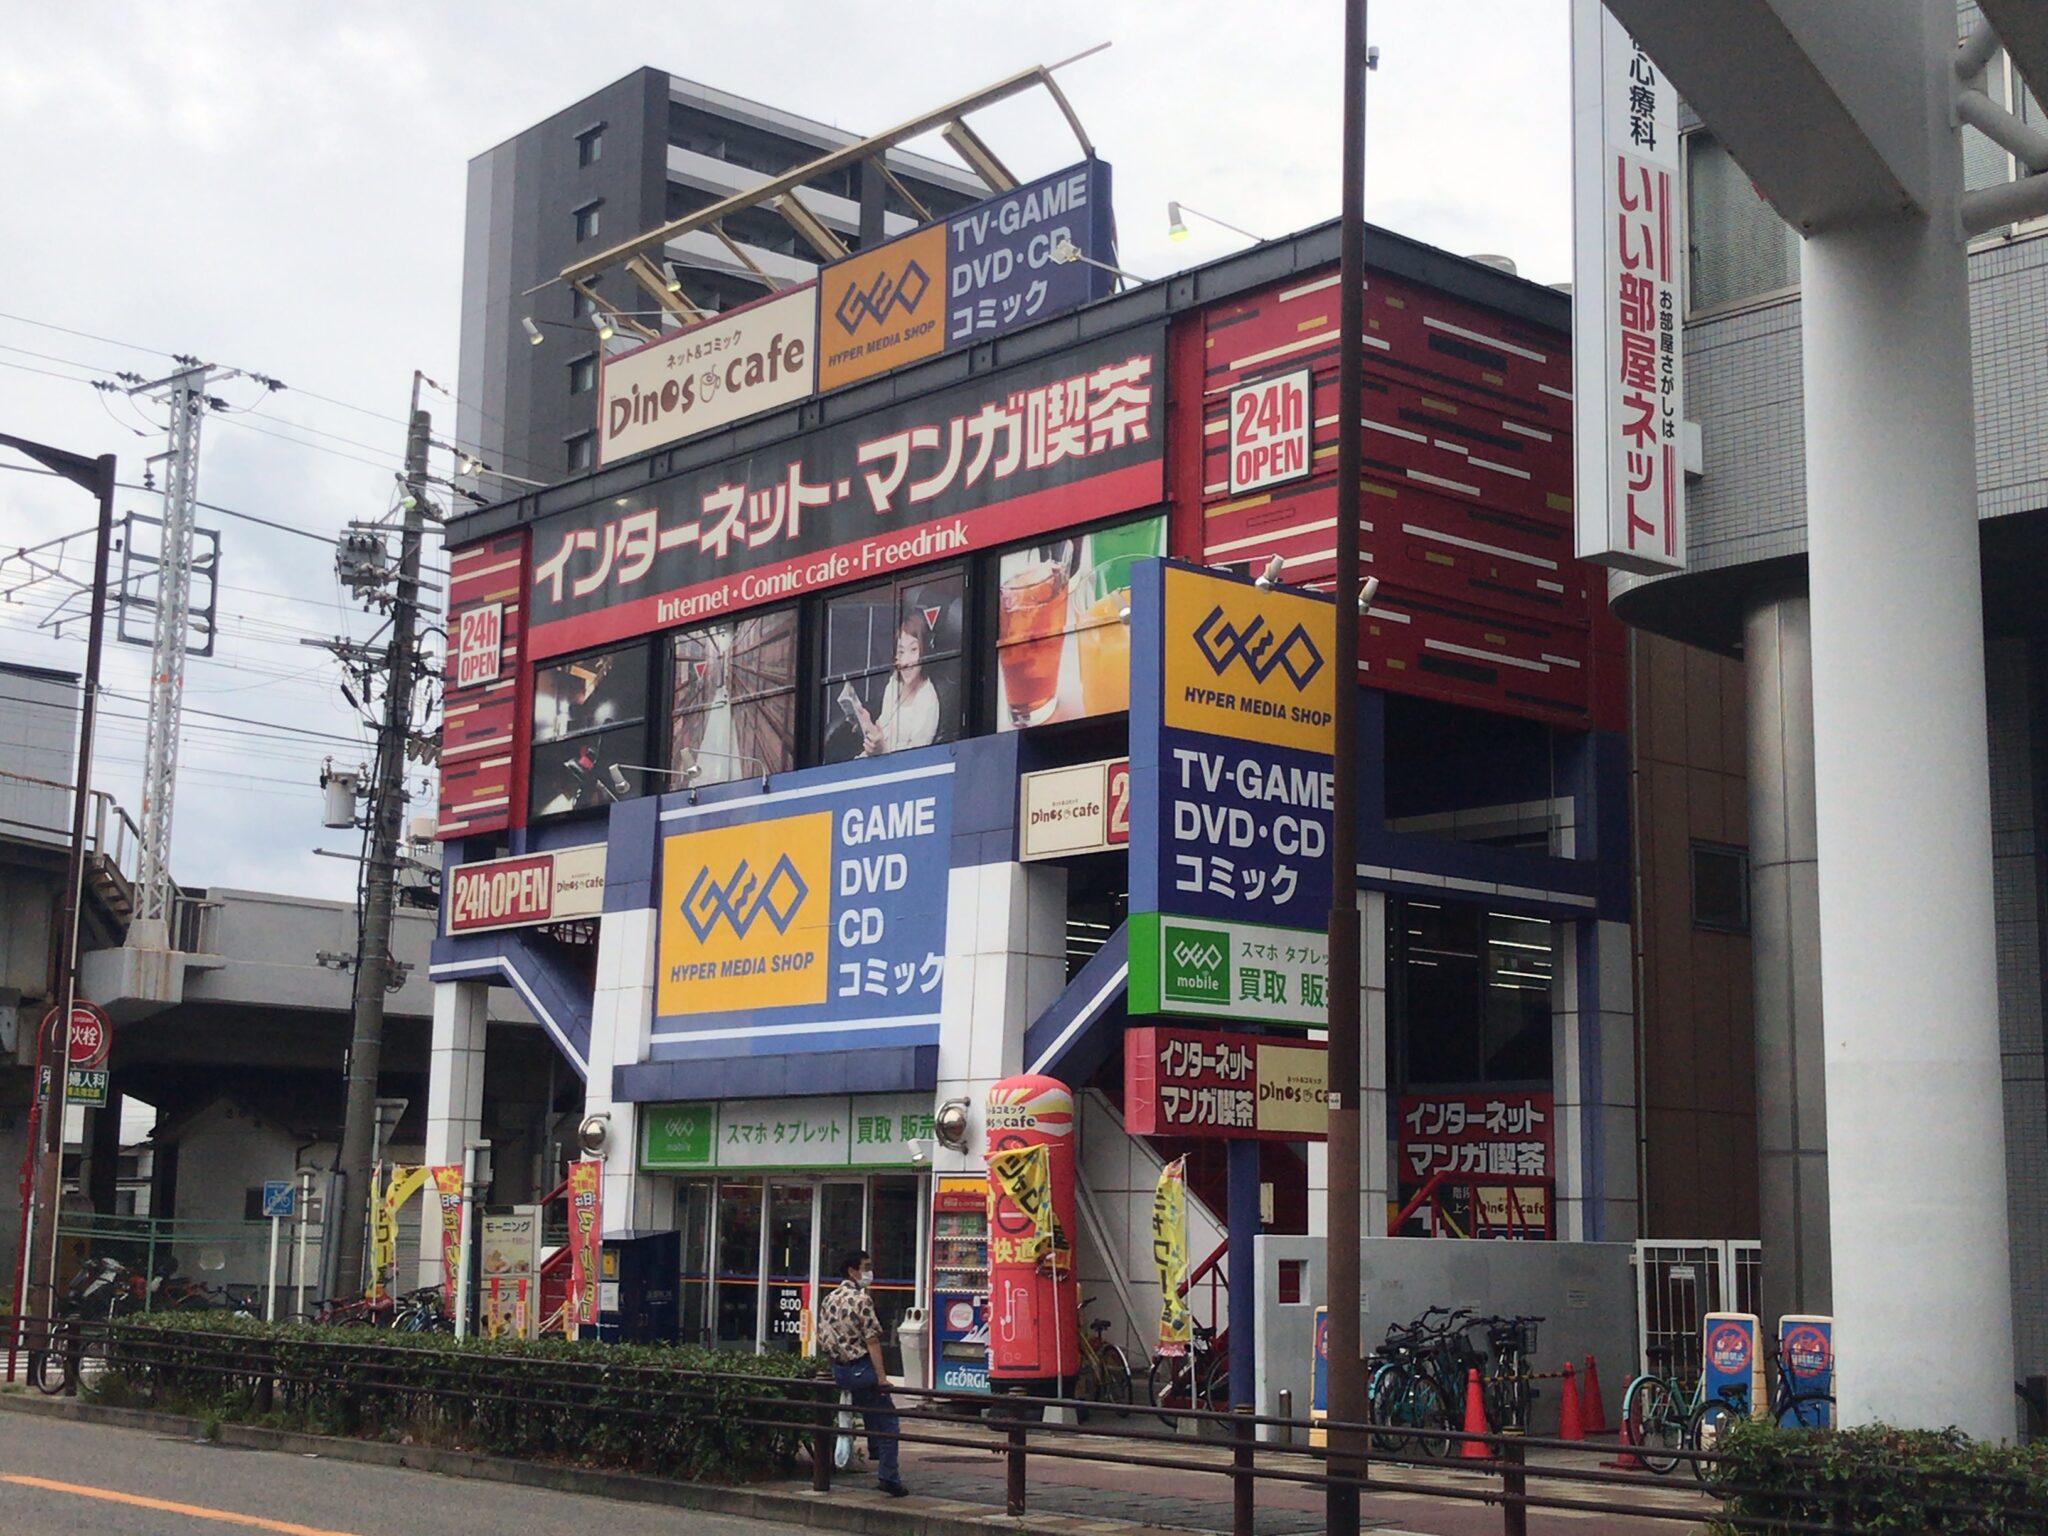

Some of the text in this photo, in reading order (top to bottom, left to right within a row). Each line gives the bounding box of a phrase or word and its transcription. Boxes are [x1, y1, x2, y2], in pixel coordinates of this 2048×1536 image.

[1628, 36, 1656, 152] 心療科
[952, 172, 1088, 254] TV-GAME
[834, 259, 931, 336] GEO
[952, 281, 1048, 341] コミック
[666, 329, 743, 369] ネット&コミック
[828, 320, 937, 368] HYPER MEDIA SHOP
[1617, 155, 1657, 550] いい部屋ネット
[1659, 289, 1675, 438] お部屋さがしは
[608, 333, 805, 440] Dinos cafe
[1235, 380, 1304, 445] 24h
[1235, 436, 1304, 486] OPEN
[656, 519, 970, 624] Internet Comic cafe Freedrink
[462, 609, 499, 653] 24h
[1192, 604, 1324, 693] GEO
[460, 649, 498, 683] OPEN
[1184, 686, 1332, 727] HYPER MEDIA SHOP
[1173, 748, 1335, 811] TV-GAME
[841, 797, 936, 846] GAME
[1031, 808, 1063, 825] Dinos
[1072, 801, 1100, 818] cafe
[1174, 799, 1326, 858] DVD・CD
[585, 876, 604, 888] cafe
[840, 853, 908, 896] DVD
[1175, 853, 1299, 905] コミック
[680, 852, 809, 945] GEO
[838, 907, 885, 948] CD
[670, 951, 815, 983] HYPER MEDIA SHOP
[1173, 940, 1223, 971] GEO
[1242, 942, 1279, 962] スマホ
[838, 952, 945, 997] コミック
[1177, 974, 1219, 991] mobile
[1238, 967, 1329, 1008] 買取 販
[1160, 1039, 1254, 1081] インターネット
[1160, 1086, 1255, 1128] マンガ喫茶
[1260, 1081, 1301, 1102] Dinos
[727, 1120, 841, 1144] スマホ タブレット
[857, 1115, 935, 1144] 買取 販売
[1003, 1116, 1036, 1128] cafe
[1406, 1099, 1545, 1135] インターネット
[1406, 1142, 1545, 1176] マンガ喫茶
[485, 1221, 531, 1233] モーニング
